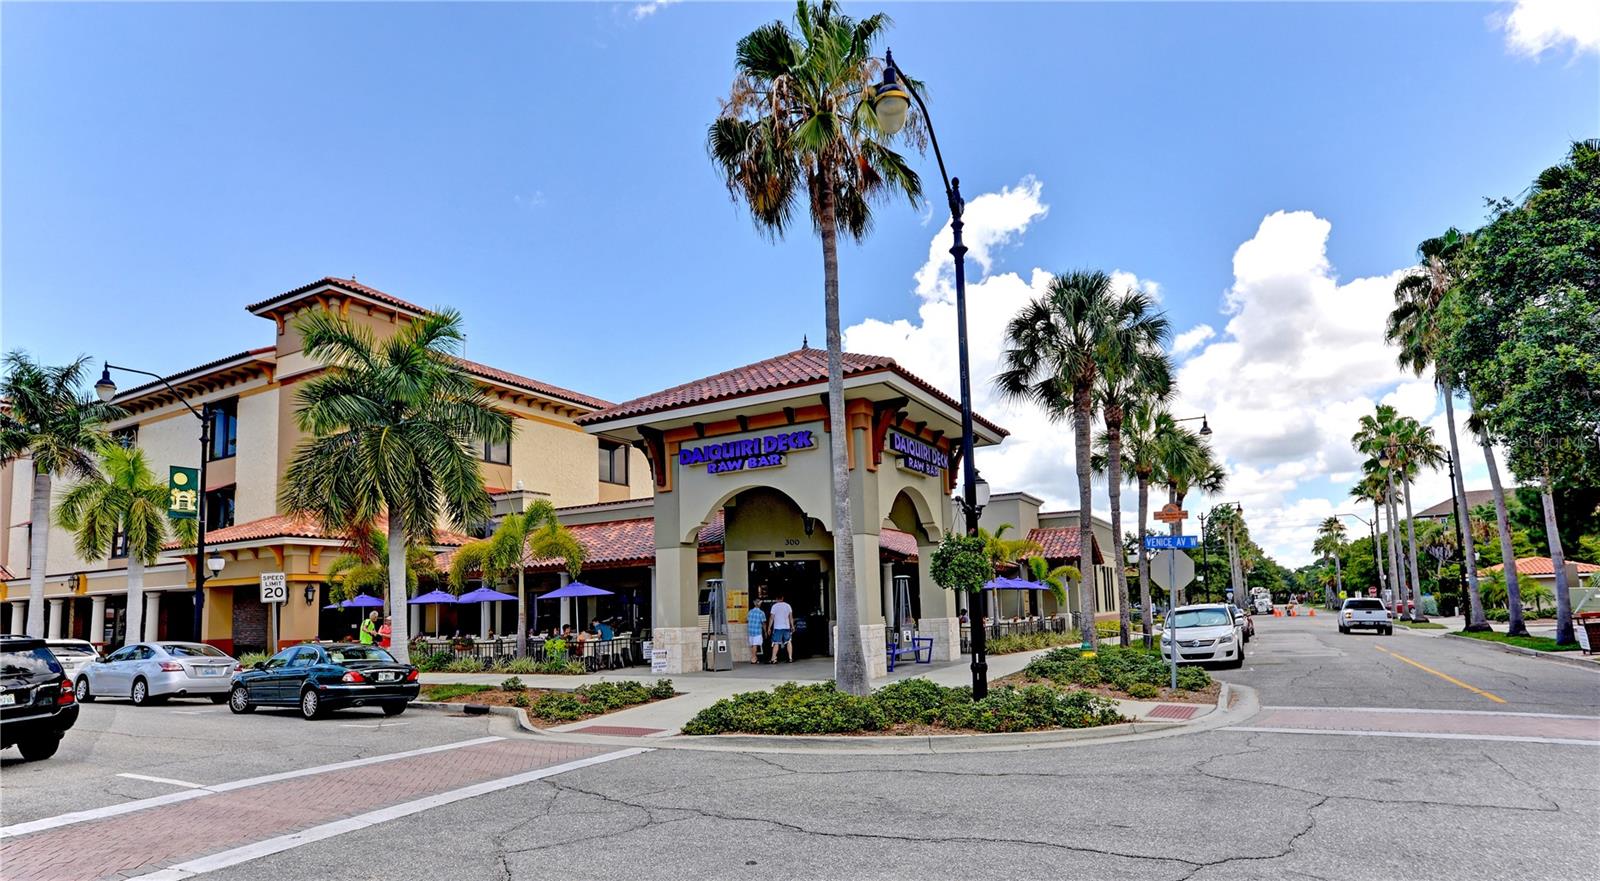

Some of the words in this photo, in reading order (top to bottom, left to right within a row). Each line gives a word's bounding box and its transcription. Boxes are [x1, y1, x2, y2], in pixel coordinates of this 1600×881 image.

[679, 437, 761, 465] DAIQUIRI
[763, 430, 812, 454] DECK
[894, 431, 931, 462] DAIQUIRI
[931, 447, 948, 468] DECK
[707, 458, 745, 474] RAW
[747, 453, 783, 469] BAR
[908, 456, 924, 472] RAW
[925, 463, 939, 477] BAR
[1146, 537, 1173, 547] VENICE
[1176, 537, 1186, 546] AV
[1190, 537, 1197, 546] W
[264, 587, 284, 598] 20
